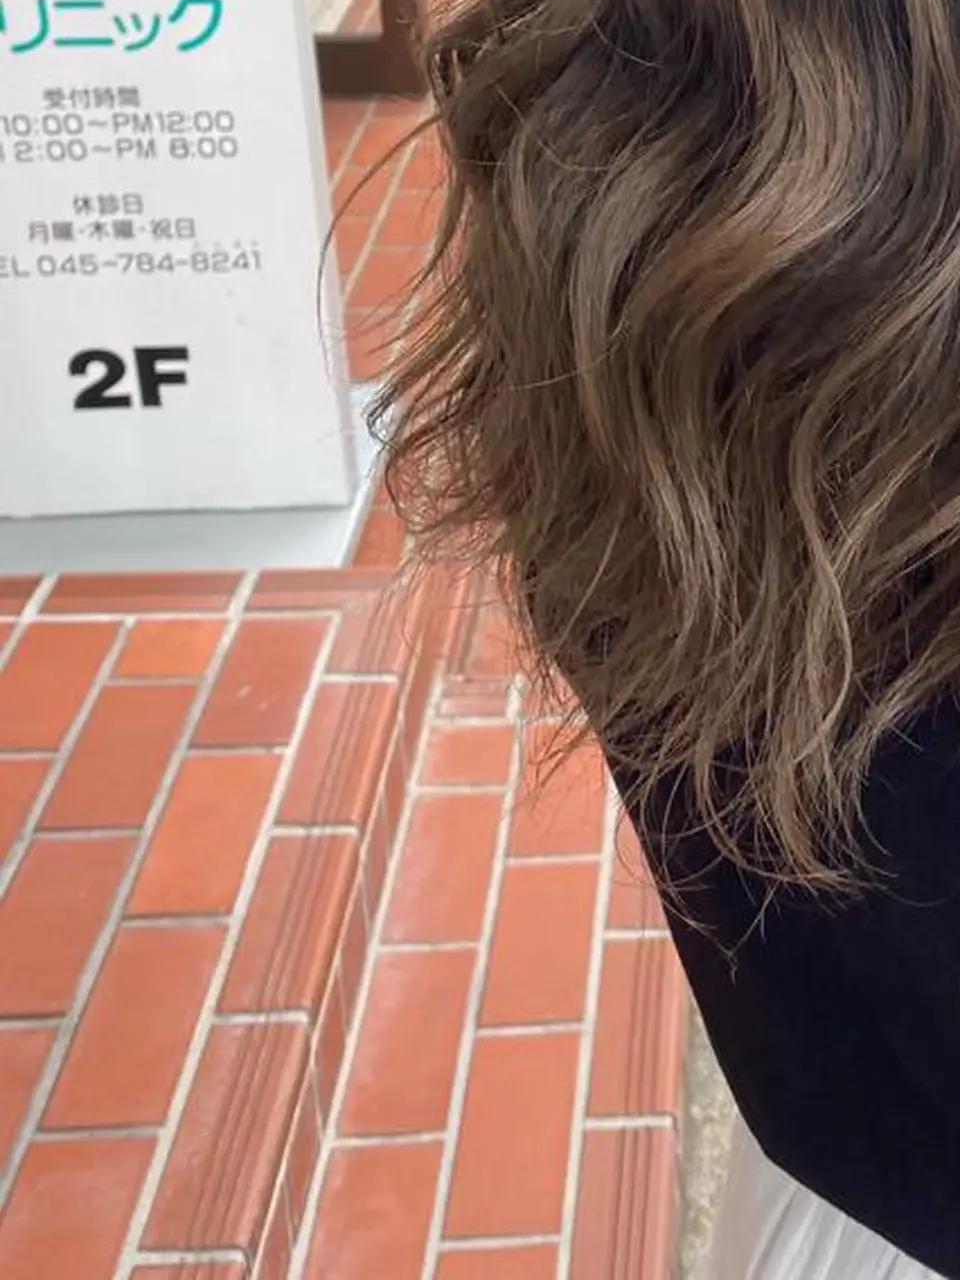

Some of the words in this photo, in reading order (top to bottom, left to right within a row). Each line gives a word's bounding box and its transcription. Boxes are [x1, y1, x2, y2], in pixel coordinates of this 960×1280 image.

[42, 86, 140, 110] 受付時間
[72, 194, 144, 216] 休診日
[36, 250, 261, 278] 045-784-8241
[68, 346, 189, 410] 2F
